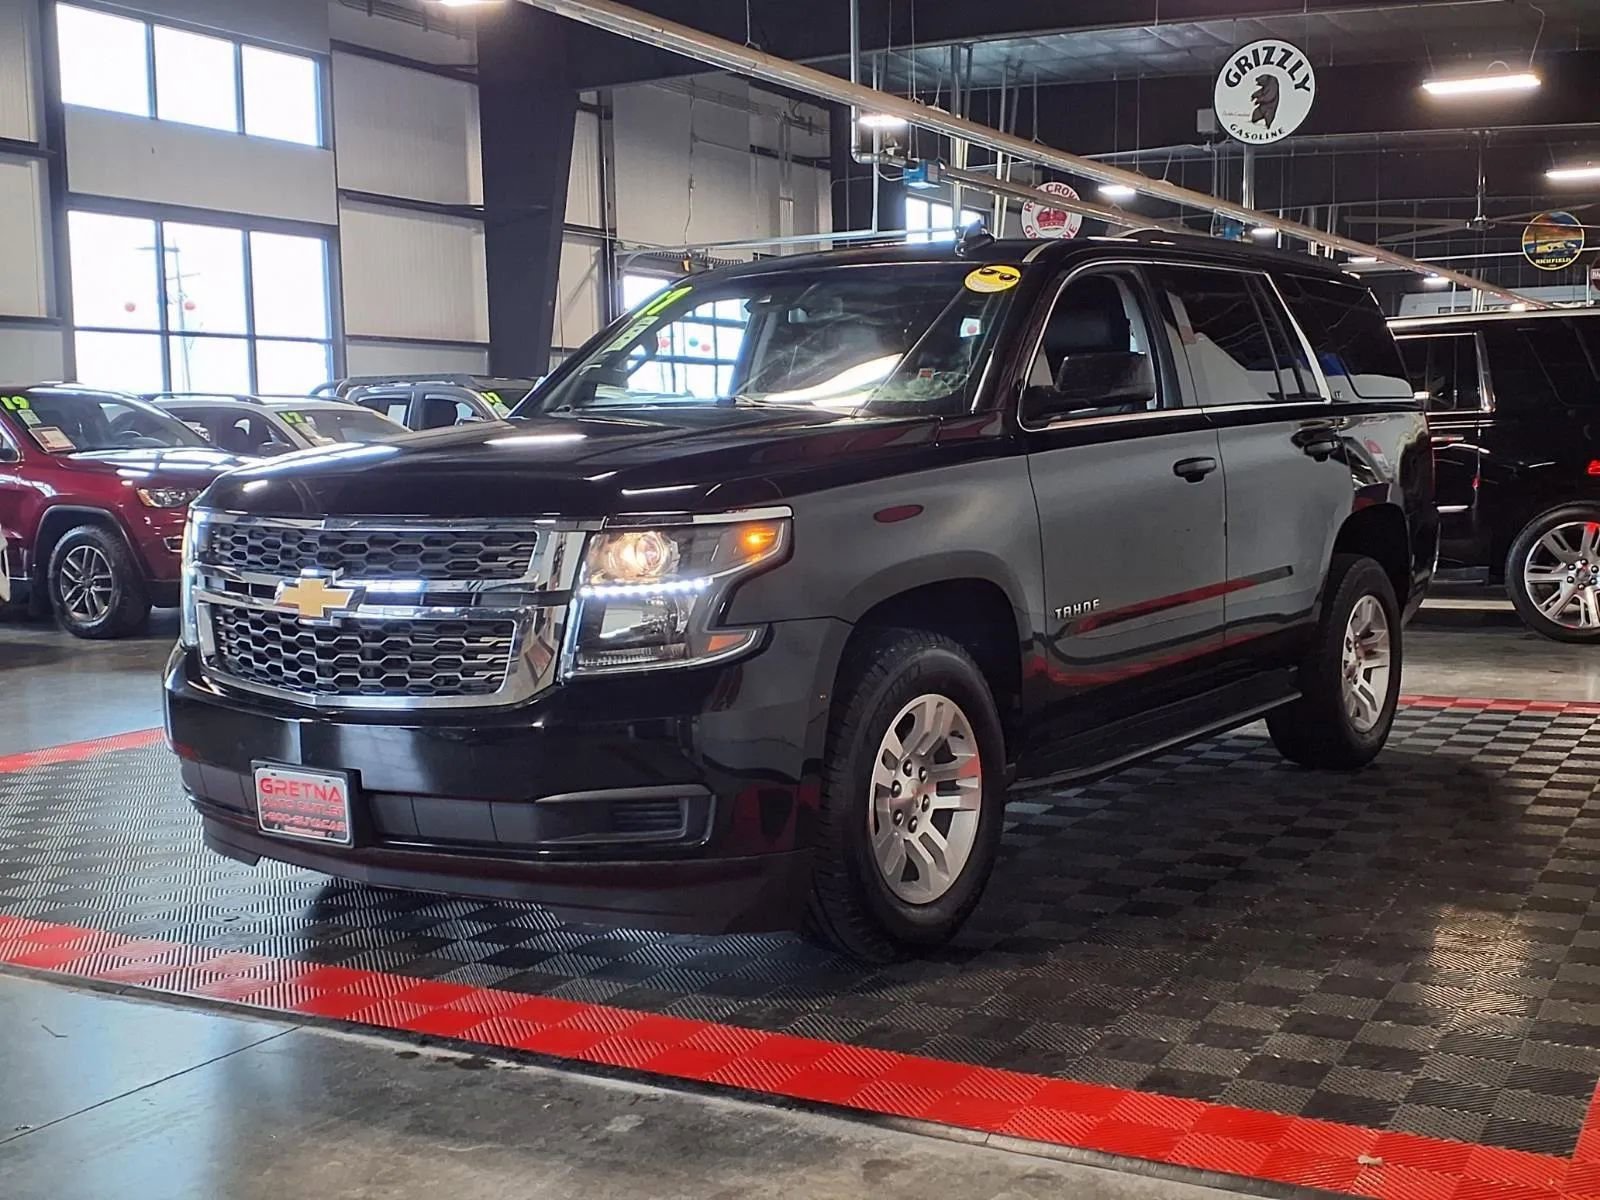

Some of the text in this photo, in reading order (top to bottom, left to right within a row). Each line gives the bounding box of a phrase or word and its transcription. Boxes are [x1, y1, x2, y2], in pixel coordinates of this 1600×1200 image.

[1224, 45, 1311, 93] GRIZZLY
[1230, 123, 1285, 140] GASOLINE
[0, 396, 30, 410] 19
[1055, 599, 1100, 619] TAHOE
[260, 778, 343, 803] GRETNA
